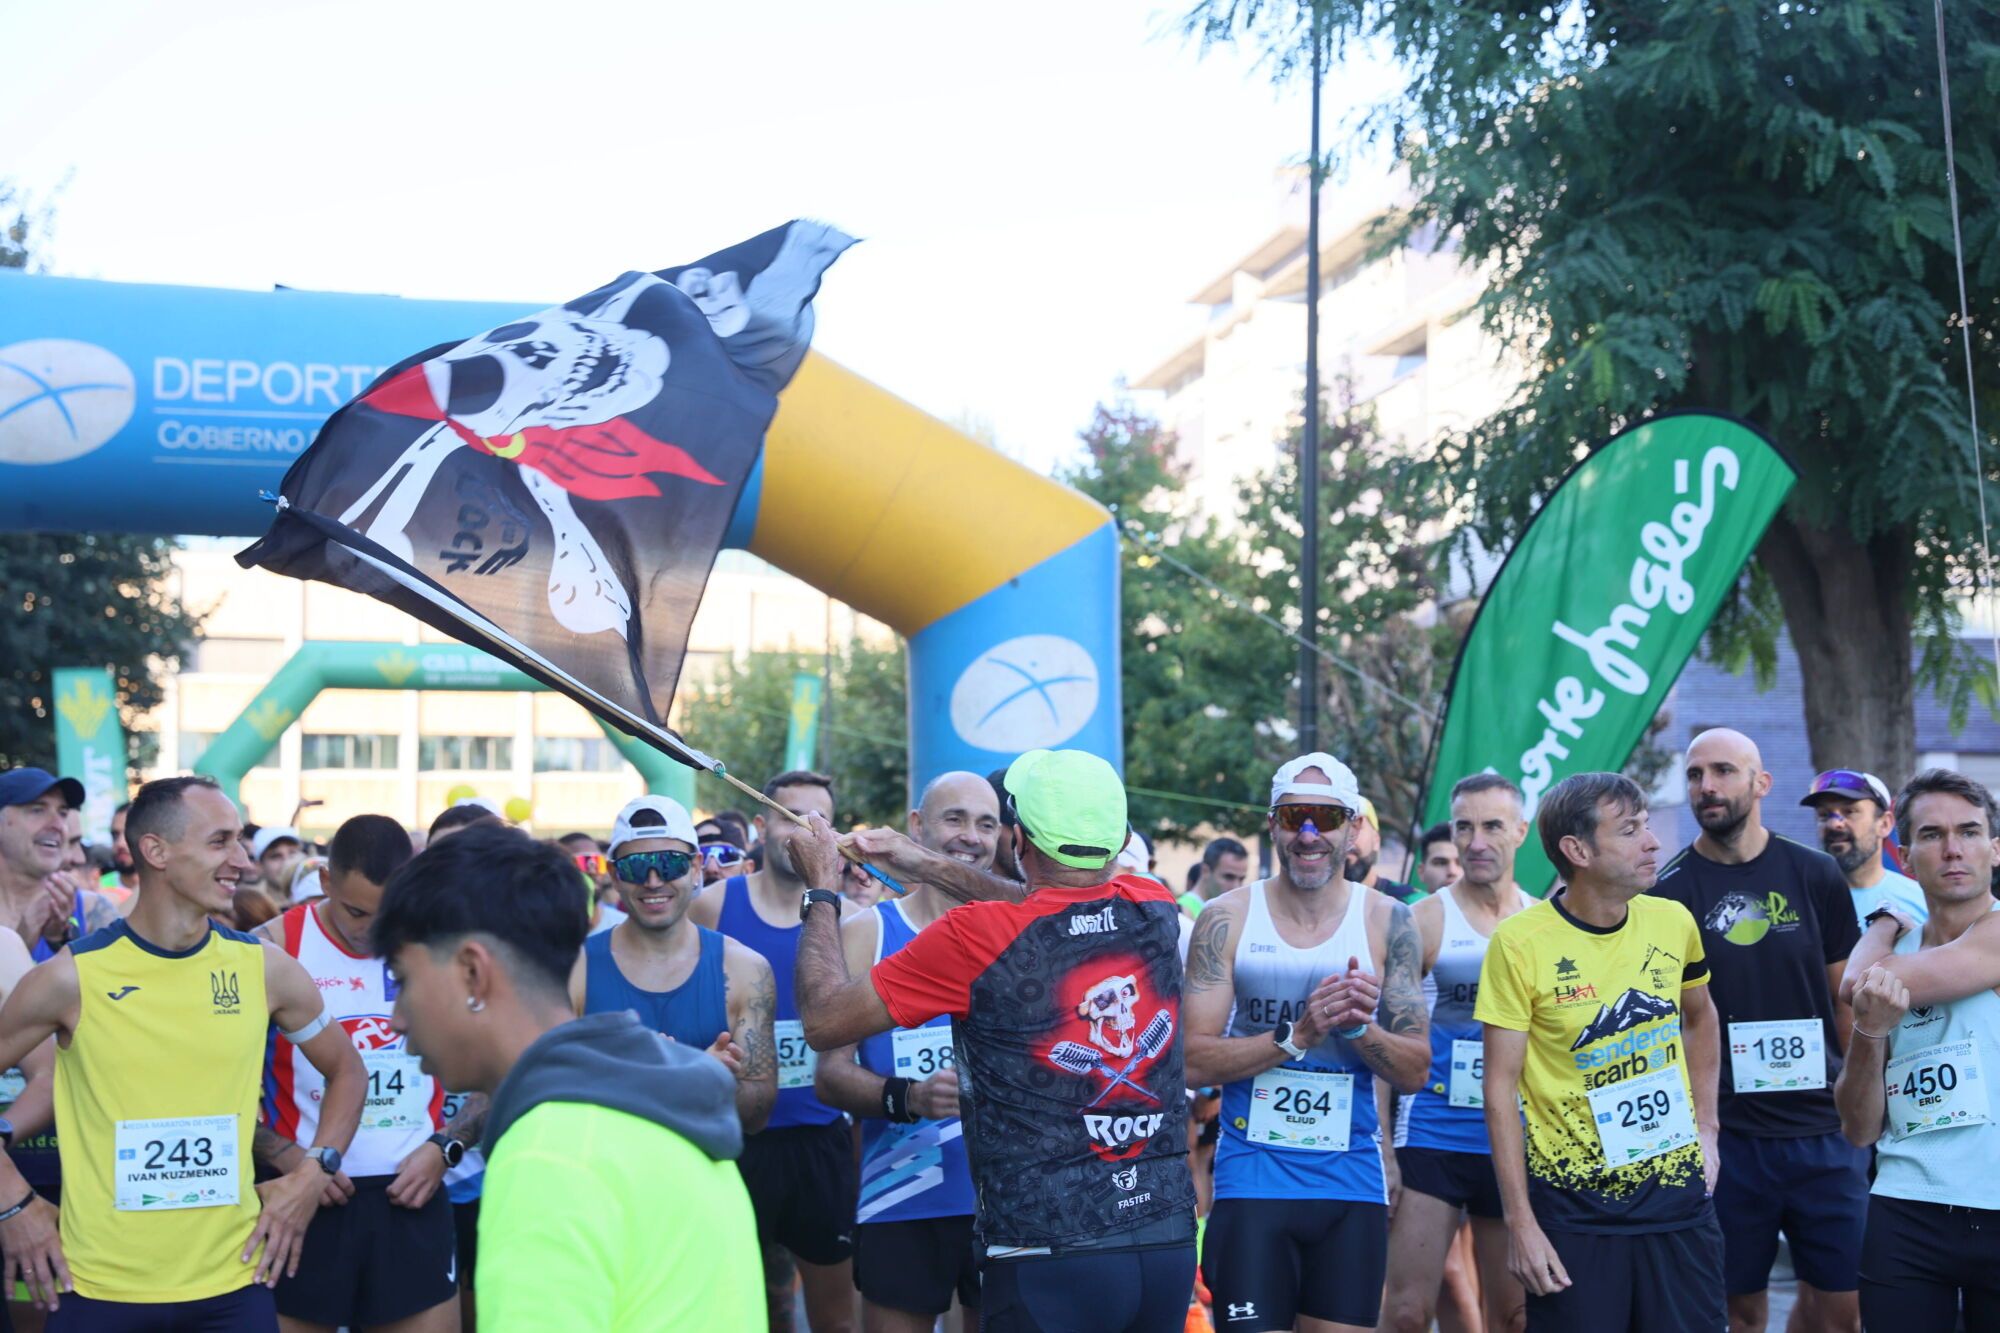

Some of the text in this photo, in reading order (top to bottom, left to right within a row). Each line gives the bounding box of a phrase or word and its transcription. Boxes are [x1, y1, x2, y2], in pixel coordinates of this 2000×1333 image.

[153, 357, 386, 406] DEPORT
[1753, 1036, 1805, 1061] 188
[1903, 1063, 1957, 1098] 450
[1273, 1086, 1331, 1116] 264
[1617, 1090, 1670, 1127] 259
[1920, 1095, 1942, 1107] ERIC
[1286, 1115, 1316, 1125] ELIUD
[1641, 1121, 1660, 1132] IBAI
[145, 1137, 213, 1170] 243
[128, 1167, 228, 1182] IVAN KUZMENKO
[1118, 1192, 1151, 1210] FASTER
